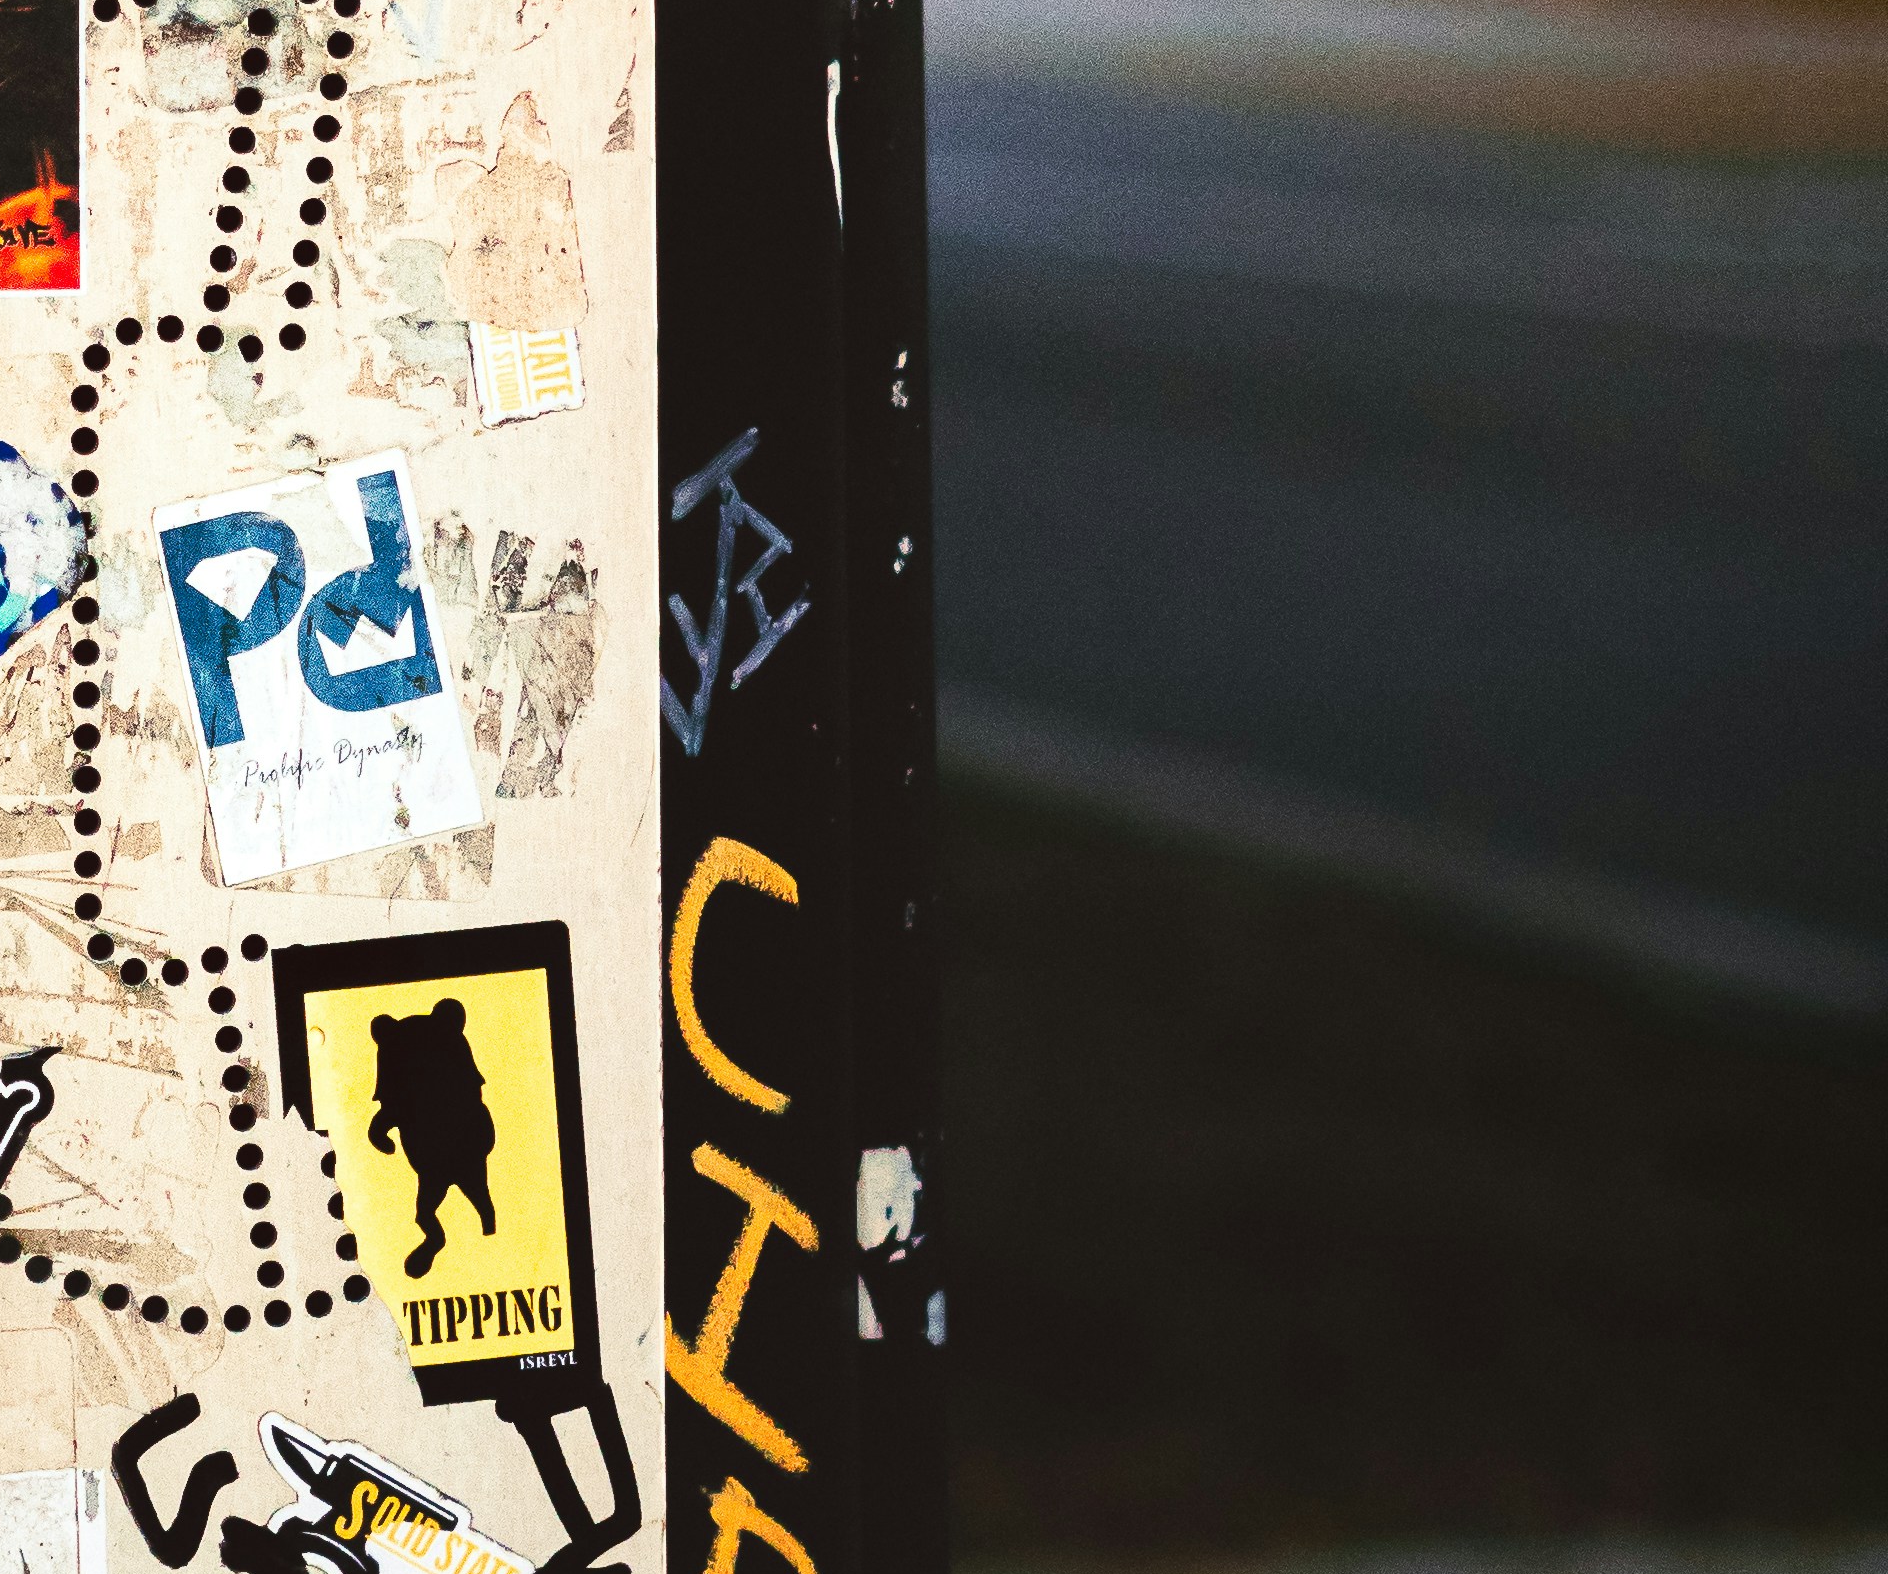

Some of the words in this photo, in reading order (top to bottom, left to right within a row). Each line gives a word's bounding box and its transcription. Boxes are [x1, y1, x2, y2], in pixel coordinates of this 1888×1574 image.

[527, 330, 575, 402] TATE
[402, 1285, 562, 1346] TIPPING
[334, 1480, 441, 1558] SOLID
